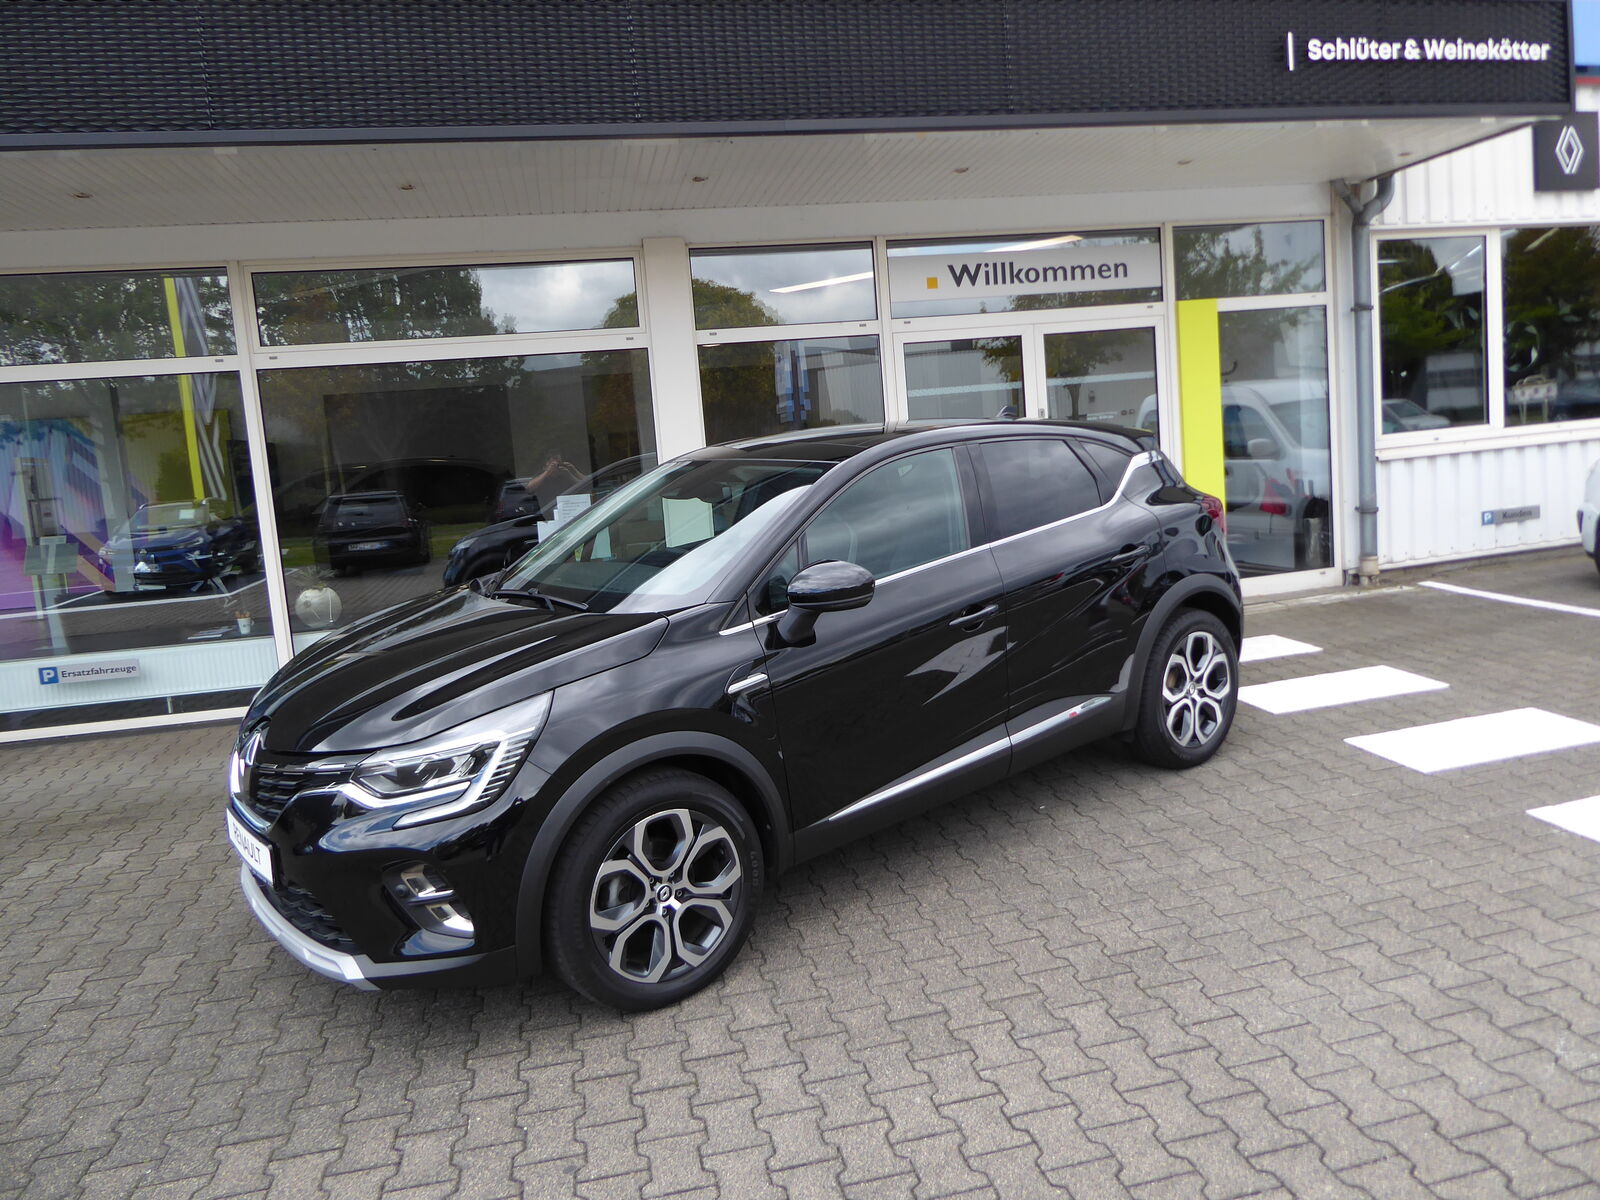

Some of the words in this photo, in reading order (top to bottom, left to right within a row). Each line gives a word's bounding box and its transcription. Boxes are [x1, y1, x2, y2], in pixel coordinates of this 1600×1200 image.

[1307, 38, 1400, 61] Schlüter
[1404, 39, 1420, 60] &
[1423, 38, 1551, 61] Weinekötter
[947, 261, 1128, 288] Willkommen
[1483, 512, 1492, 523] P
[43, 669, 55, 682] P
[61, 664, 137, 678] Ersatzfahrzeuge
